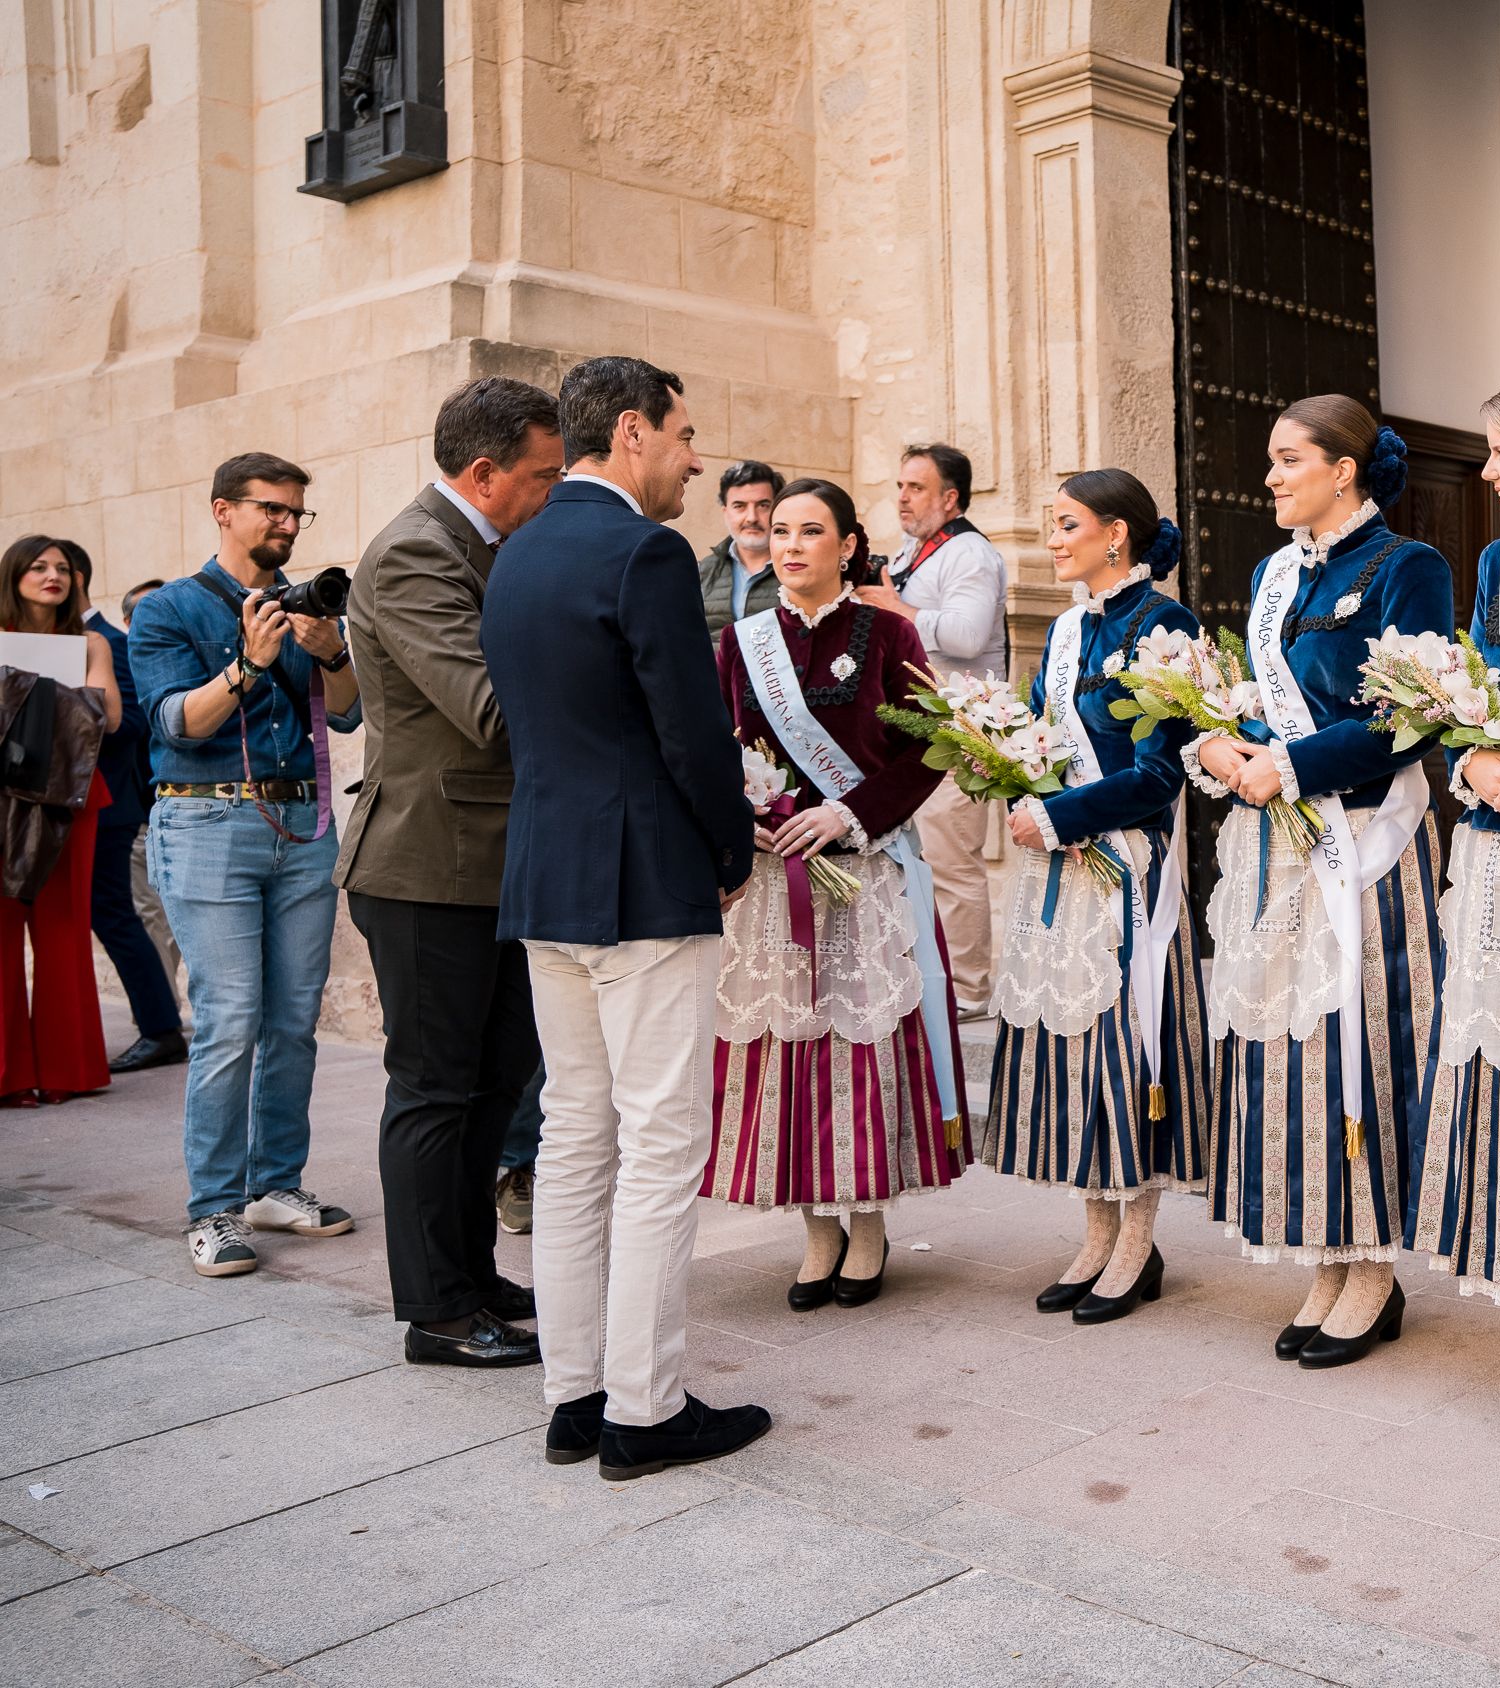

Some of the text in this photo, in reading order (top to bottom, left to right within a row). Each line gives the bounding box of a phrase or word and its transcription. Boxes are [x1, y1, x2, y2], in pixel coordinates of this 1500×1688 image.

[1257, 591, 1283, 652] DAMA
[1056, 662, 1070, 724] DAMA
[1266, 667, 1287, 702] DE
